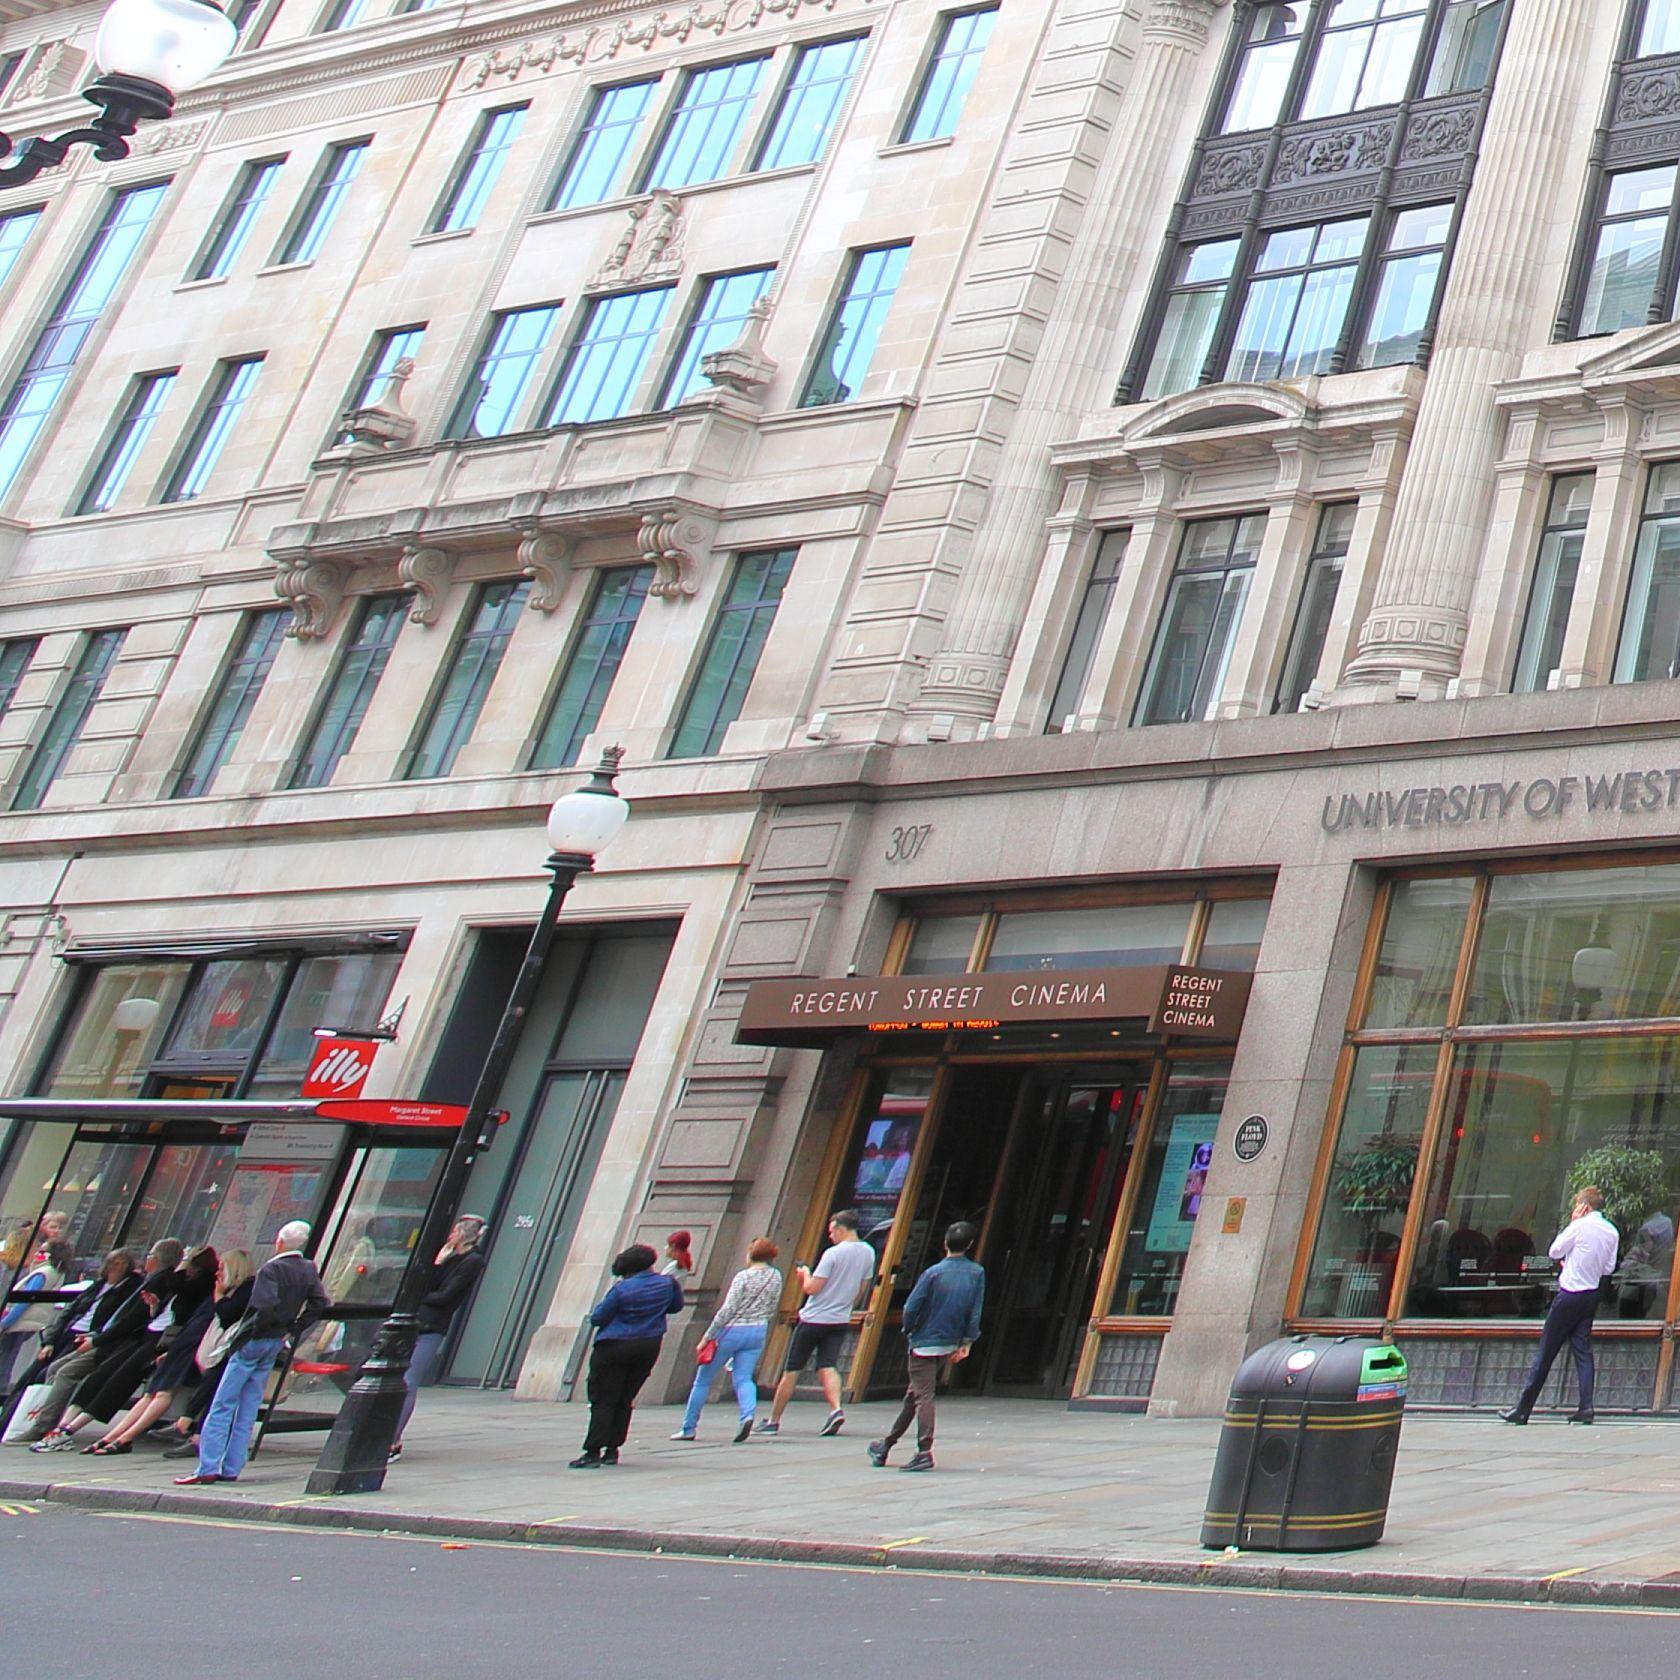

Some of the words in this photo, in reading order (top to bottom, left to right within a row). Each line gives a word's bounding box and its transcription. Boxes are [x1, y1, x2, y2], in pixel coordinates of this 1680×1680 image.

[1319, 781, 1521, 833] UNIVERSITY
[1522, 775, 1577, 818] OF
[885, 823, 933, 861] 307
[1171, 974, 1223, 993] REGENT
[790, 990, 879, 1014] REGENT
[903, 986, 984, 1011] STREET
[1010, 982, 1107, 1007] CINEMA
[1166, 991, 1212, 1009] STREET
[1163, 1010, 1216, 1028] CINEMA
[310, 1048, 369, 1093] illy
[421, 1107, 442, 1116] Street
[1240, 1132, 1263, 1142] FLOYD
[1244, 1124, 1261, 1133] PINK
